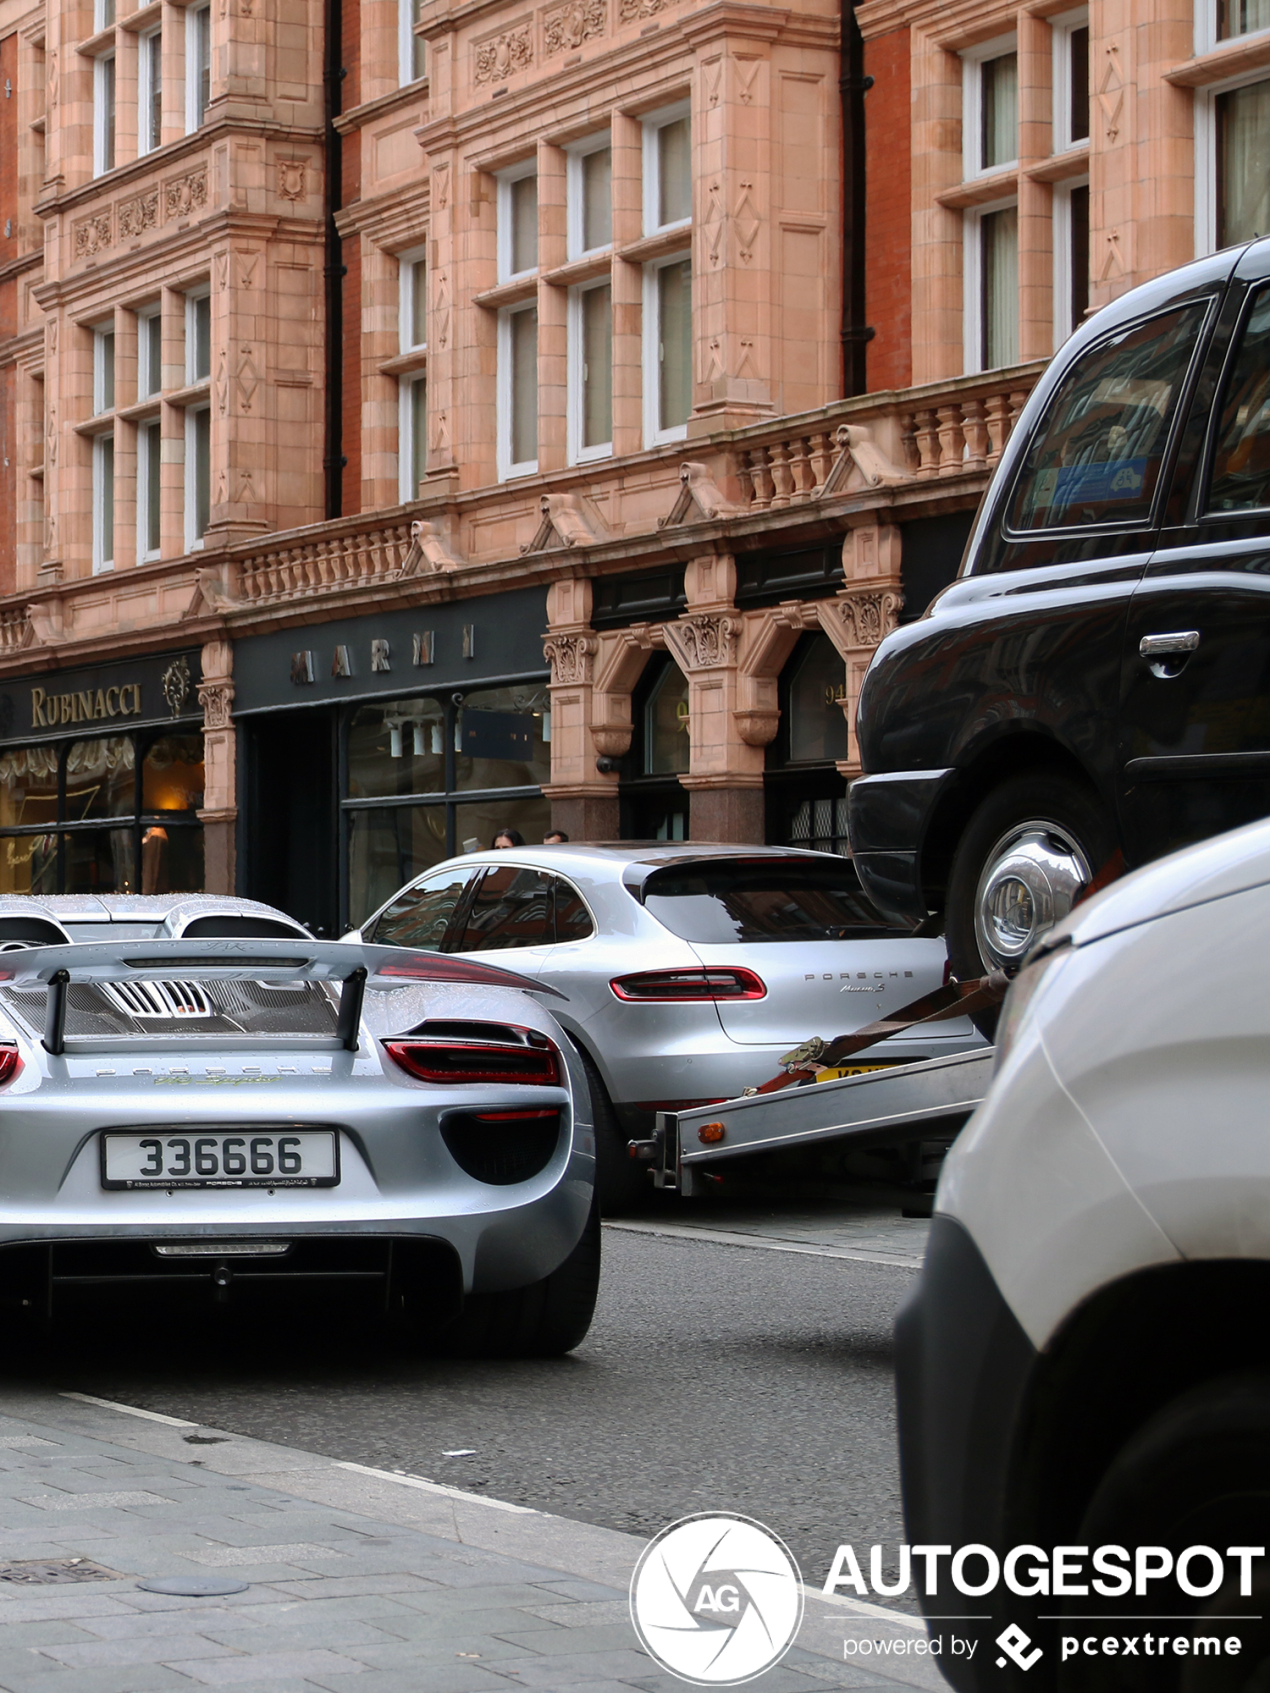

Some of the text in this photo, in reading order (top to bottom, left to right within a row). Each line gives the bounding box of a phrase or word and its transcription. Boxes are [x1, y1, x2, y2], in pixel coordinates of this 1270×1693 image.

[290, 624, 475, 684] MARNI
[825, 684, 846, 705] 94
[804, 971, 914, 981] PORSCHE
[96, 1066, 332, 1077] PORSCHE
[139, 1137, 302, 1176] 336666
